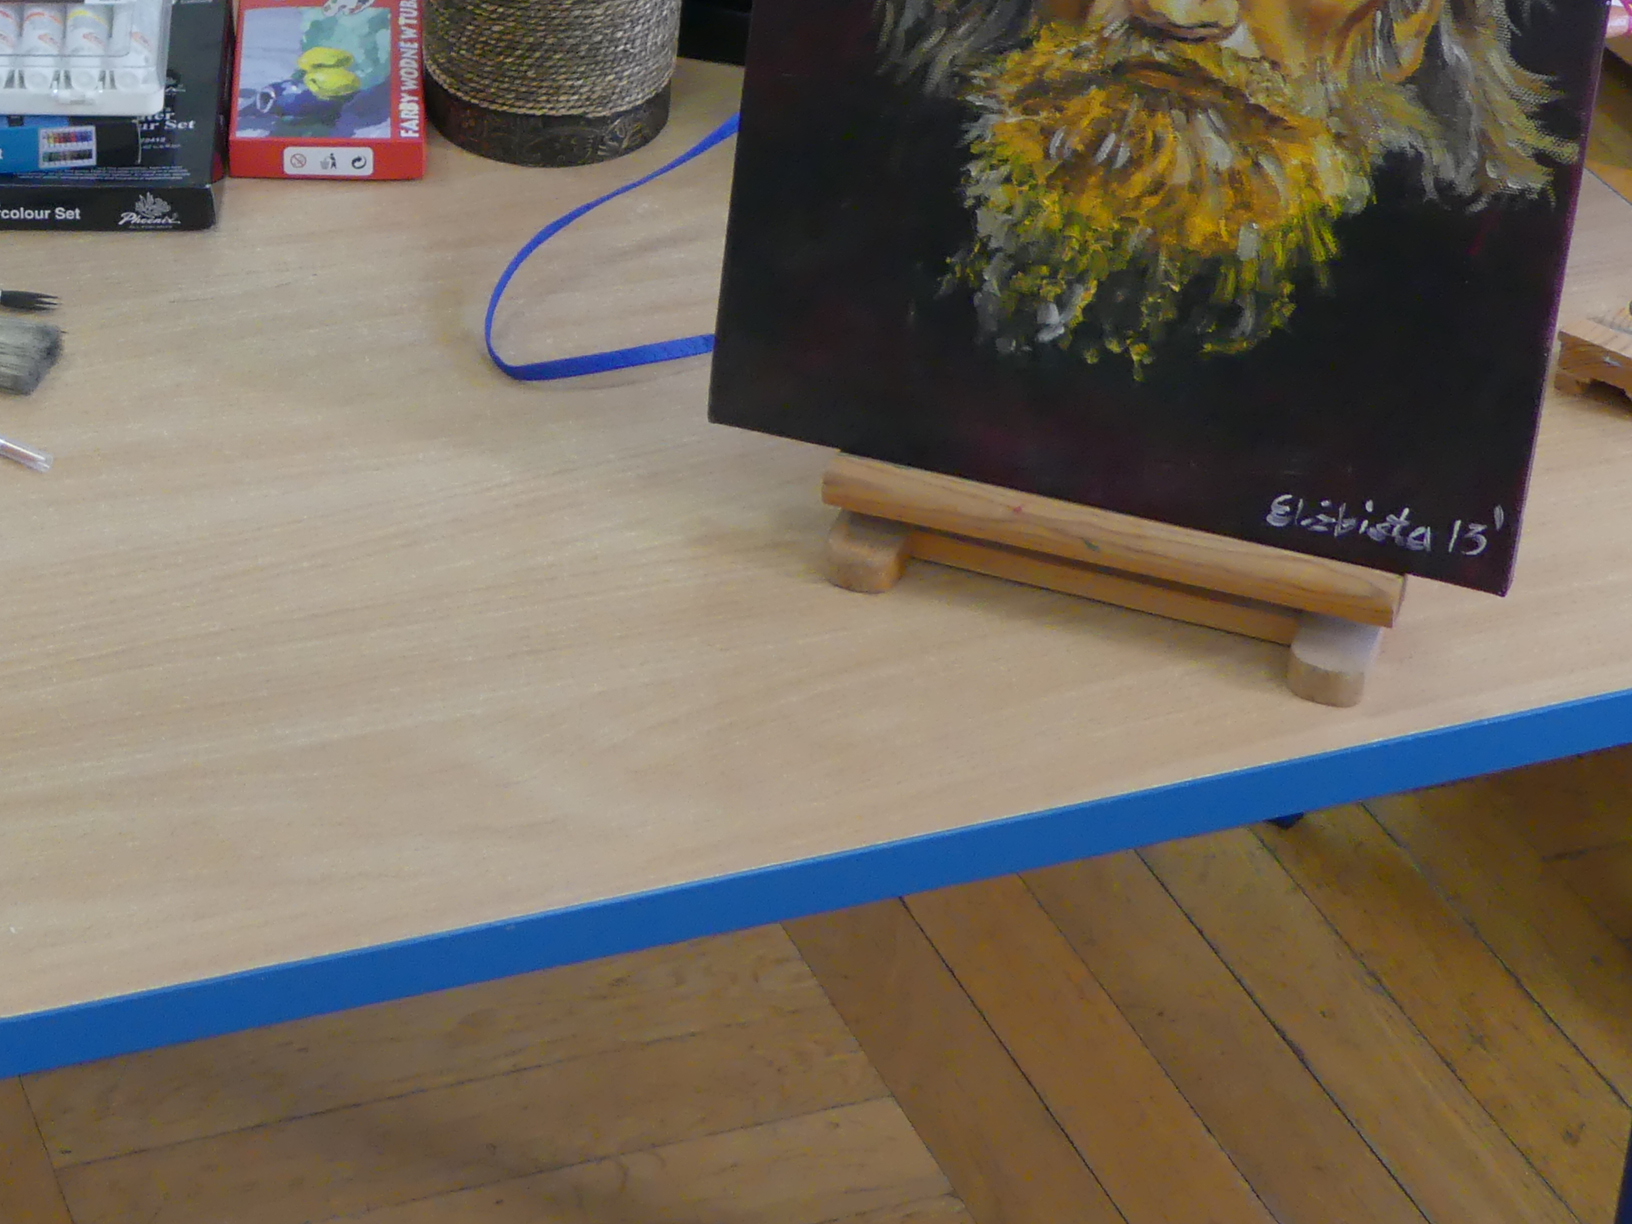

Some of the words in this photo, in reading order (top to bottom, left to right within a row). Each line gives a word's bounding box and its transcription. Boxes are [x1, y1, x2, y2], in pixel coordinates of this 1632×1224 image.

[400, 26, 418, 40] W
[398, 42, 419, 90] WODNE
[399, 93, 420, 138] FARBY
[55, 207, 82, 220] Set
